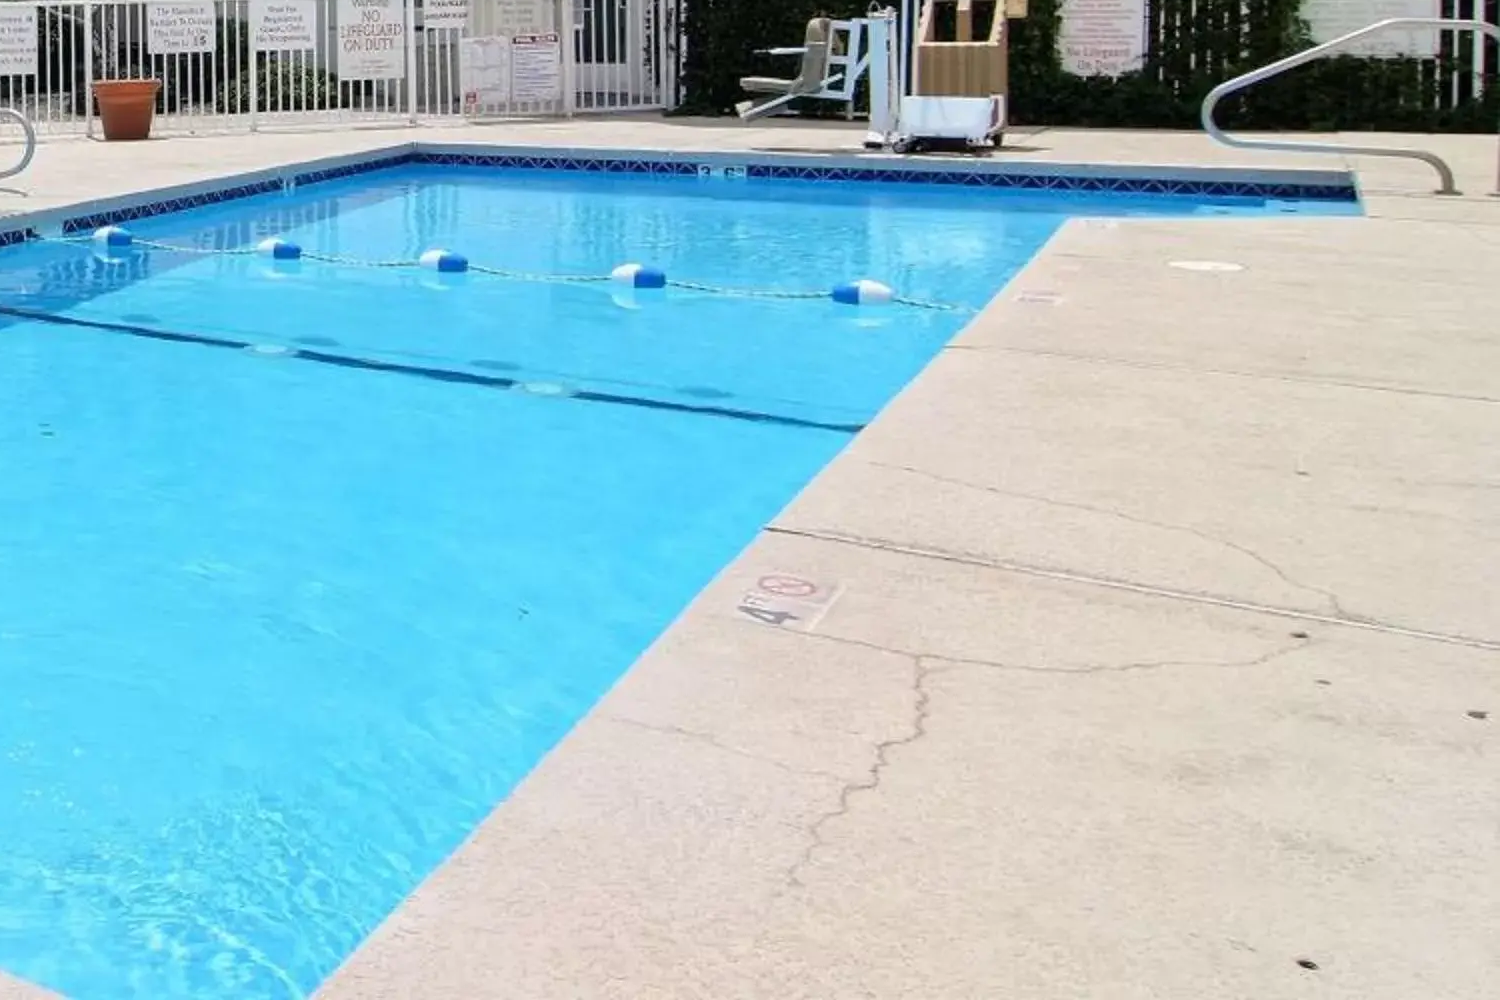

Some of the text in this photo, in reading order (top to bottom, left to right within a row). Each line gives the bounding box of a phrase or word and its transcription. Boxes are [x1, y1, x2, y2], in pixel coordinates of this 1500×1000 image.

[362, 9, 381, 22] NO
[340, 23, 402, 38] LIFEGUARD
[343, 38, 394, 52] ON DUTY
